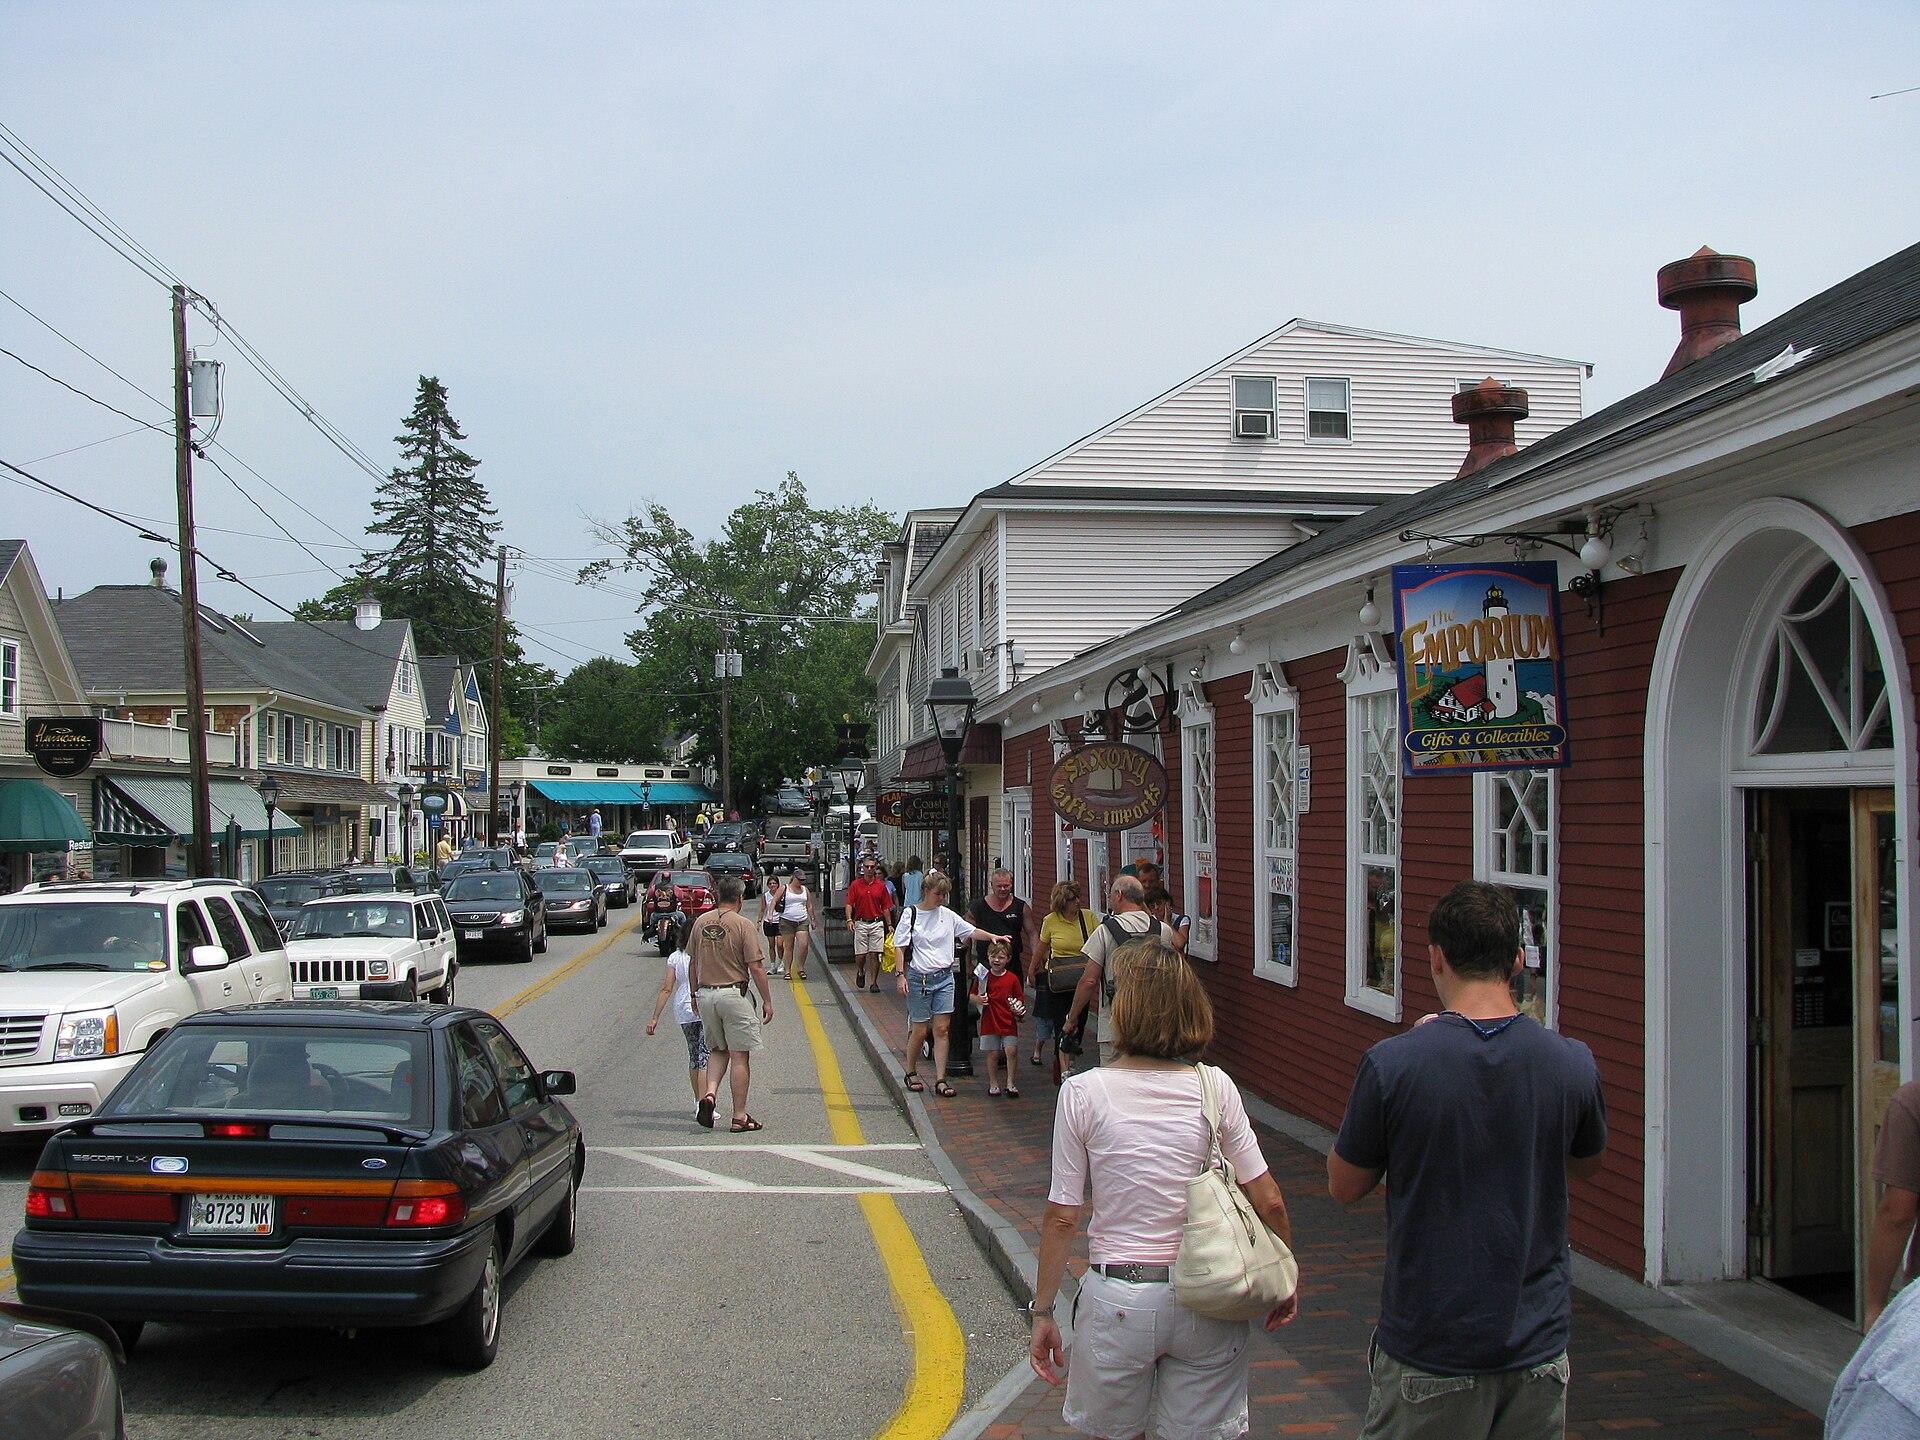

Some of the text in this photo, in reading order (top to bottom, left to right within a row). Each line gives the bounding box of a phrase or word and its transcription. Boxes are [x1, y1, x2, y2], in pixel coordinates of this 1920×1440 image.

[1428, 608, 1456, 627] The
[1401, 613, 1560, 704] EMPORIUM
[1421, 729, 1551, 750] Gifts & Collectibles
[72, 1153, 149, 1164] ESCORT LX
[205, 1202, 270, 1225] 8729 NK
